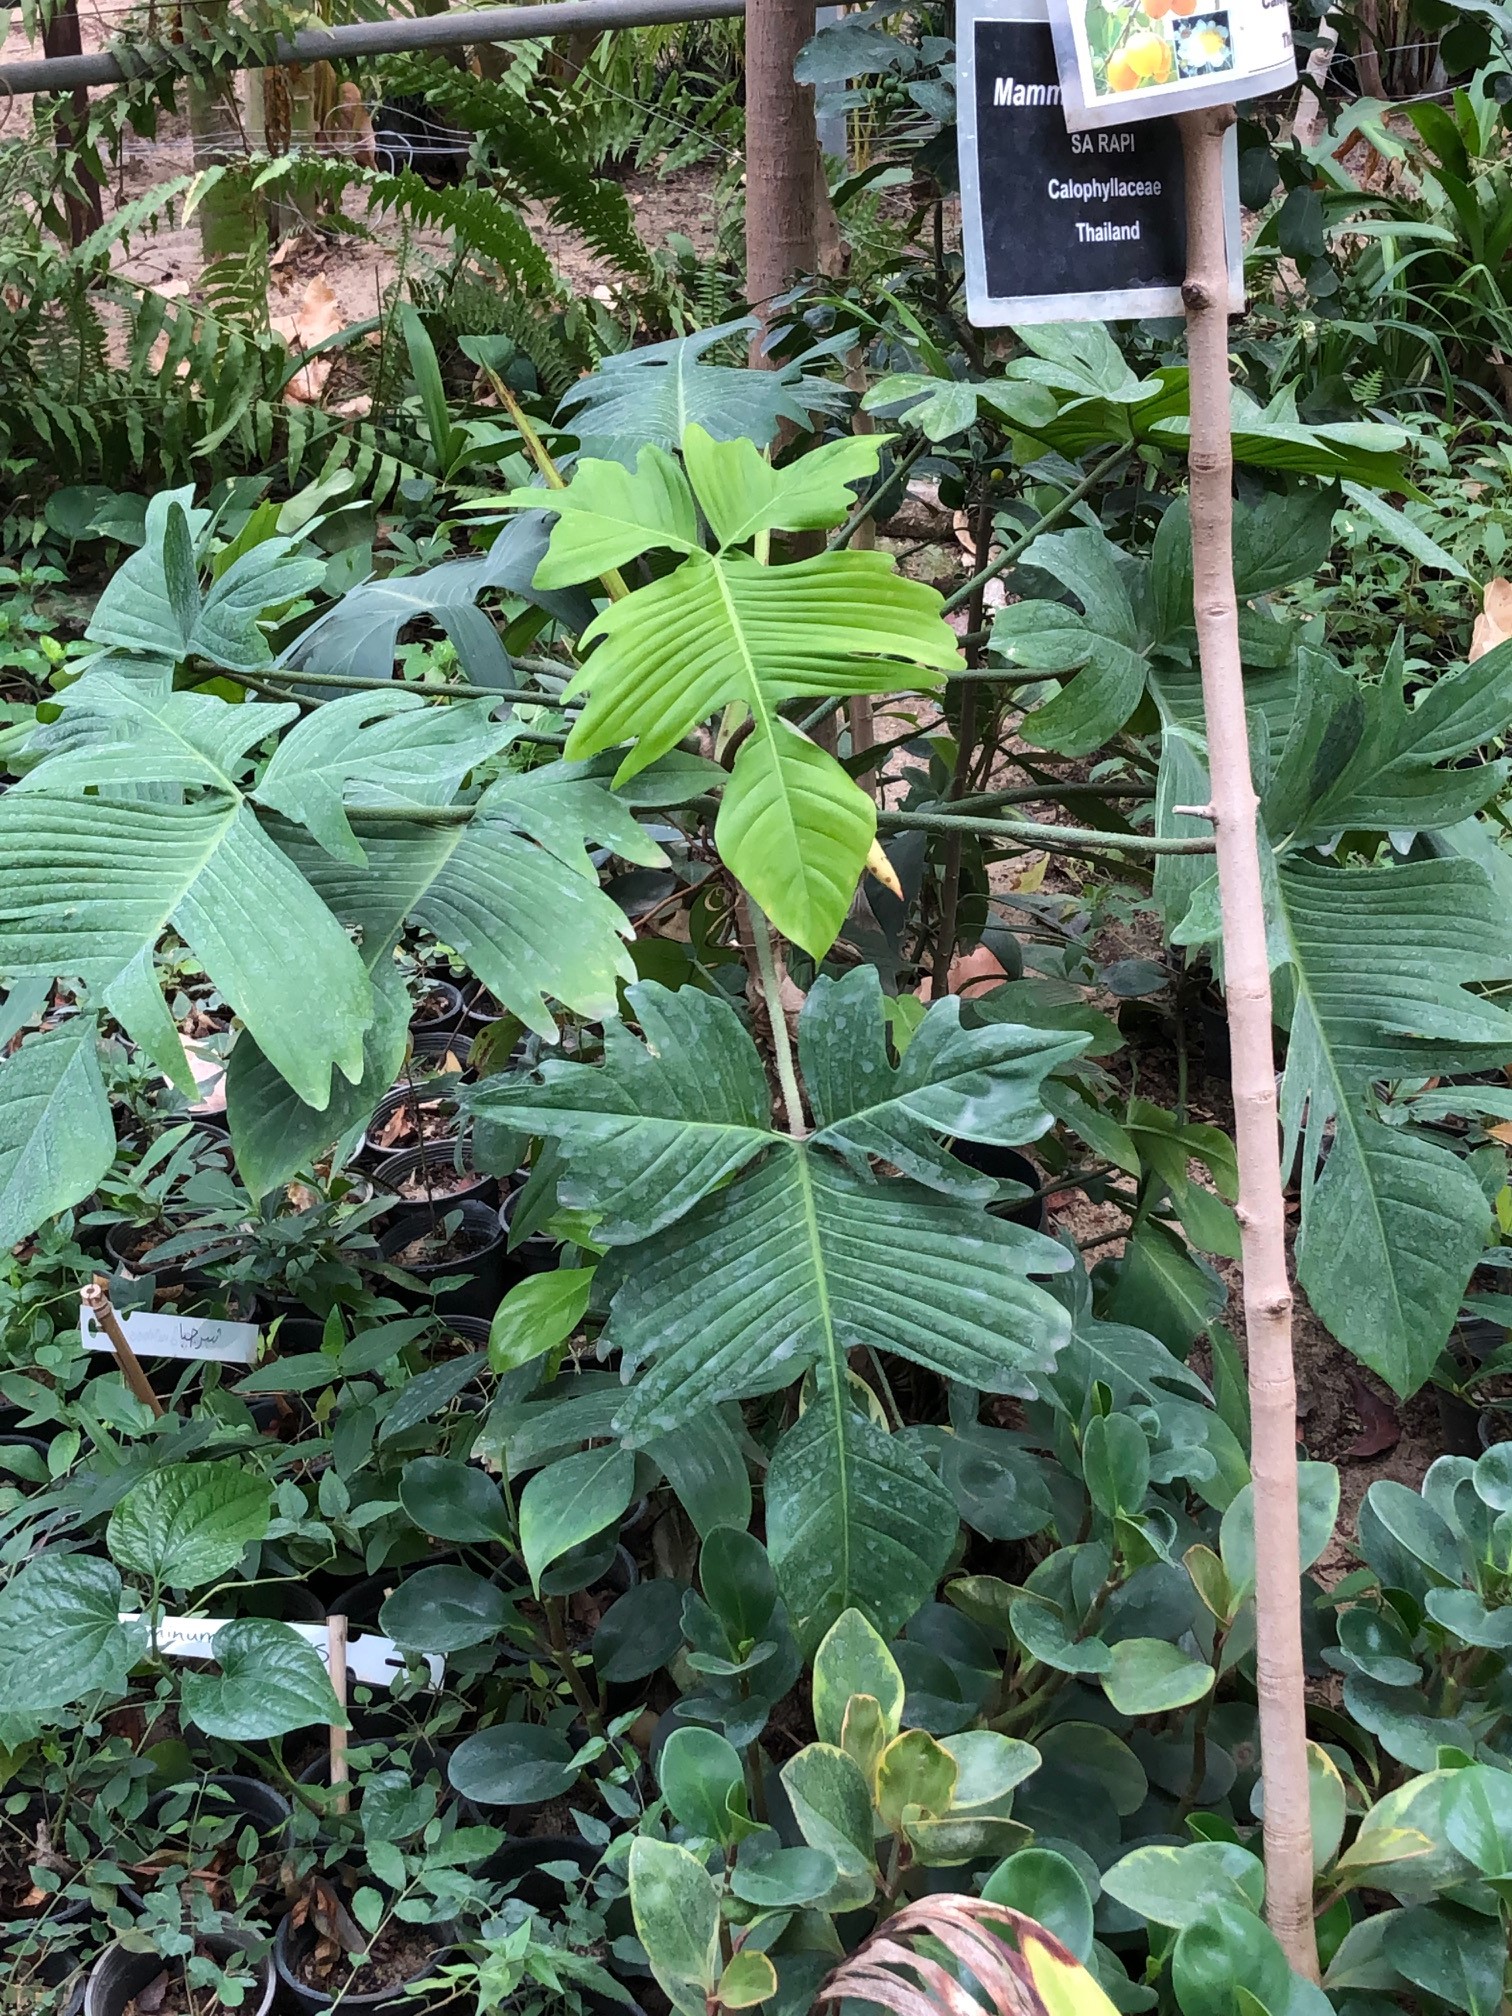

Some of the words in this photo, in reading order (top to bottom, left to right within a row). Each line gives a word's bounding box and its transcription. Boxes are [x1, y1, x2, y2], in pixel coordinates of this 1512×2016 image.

[1071, 133, 1094, 154] SA
[1098, 133, 1135, 153] RAPI
[1048, 177, 1162, 203] Calophyllaceae
[1075, 220, 1141, 242] Thailand
